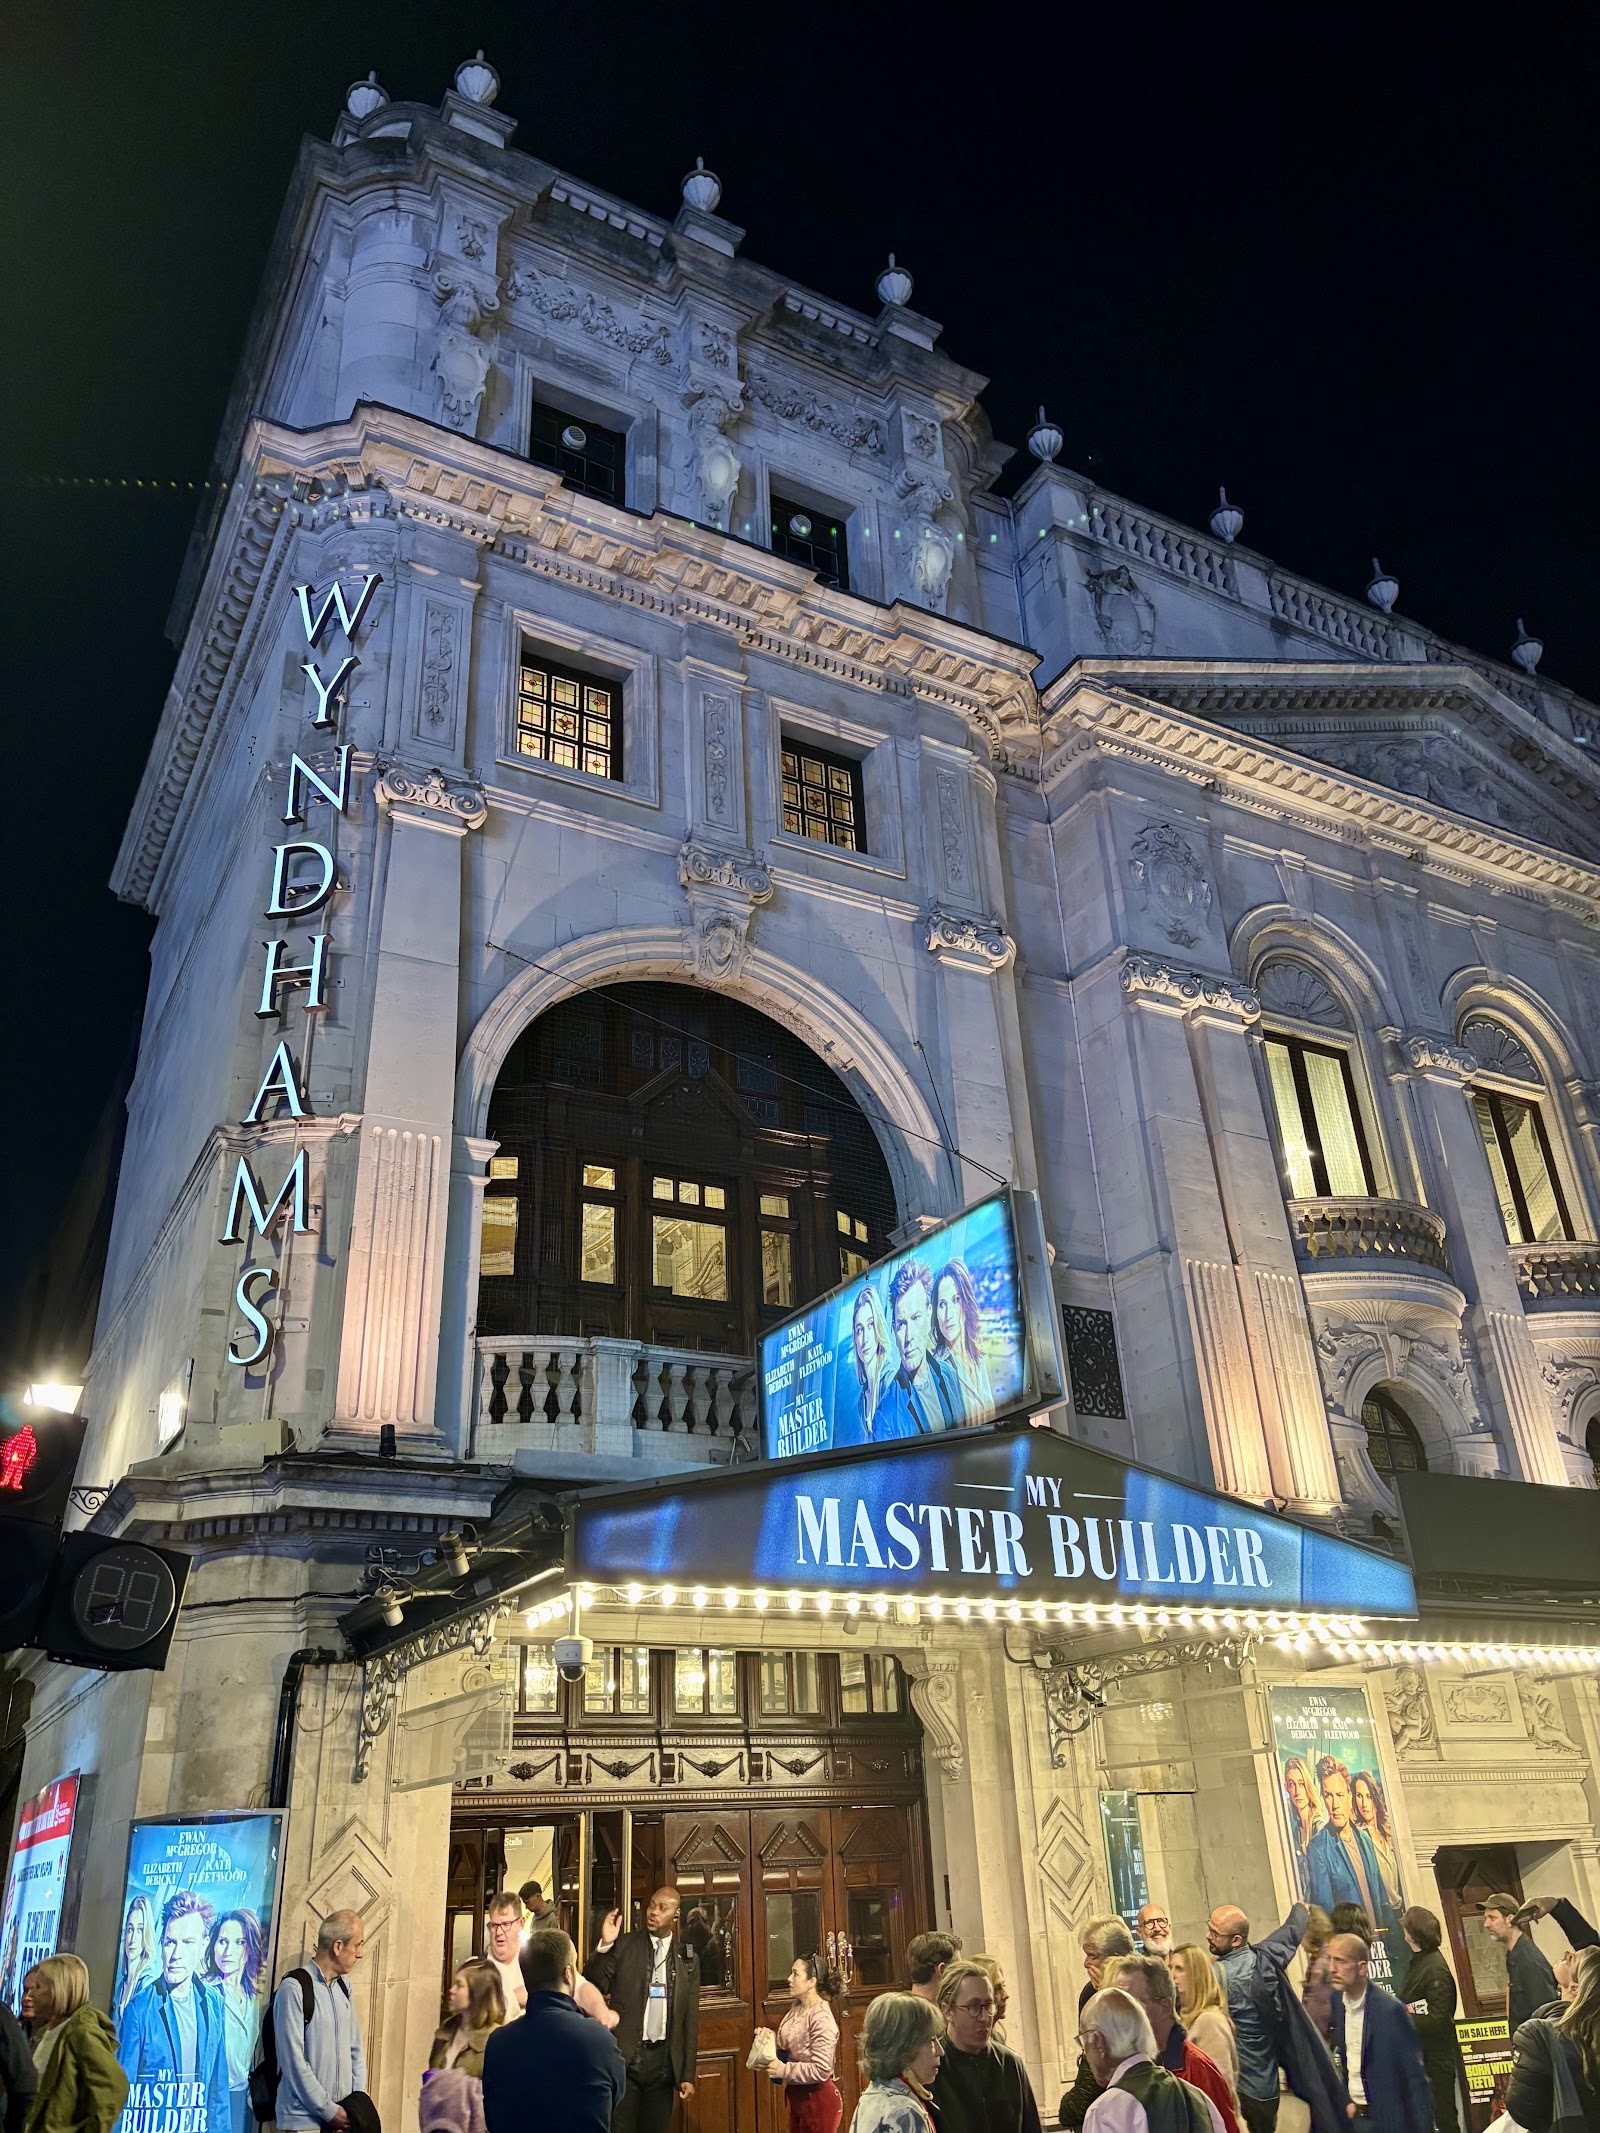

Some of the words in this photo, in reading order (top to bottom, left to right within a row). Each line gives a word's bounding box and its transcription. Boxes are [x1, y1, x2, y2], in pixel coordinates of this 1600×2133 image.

[220, 573, 384, 1366] WYNDHAMS
[788, 1321, 805, 1342] EWAN
[781, 1331, 813, 1359] McGREGOR
[808, 1343, 823, 1361] KATE
[765, 1359, 794, 1385] ELIZABETH
[800, 1350, 832, 1379] FLEETWOOD
[769, 1373, 791, 1395] DEBICKI
[796, 1392, 804, 1407] MY
[779, 1397, 824, 1438] MASTER
[778, 1419, 828, 1458] BUILDER
[1025, 1475, 1062, 1508] MY
[795, 1495, 1033, 1577] MASTER
[1047, 1514, 1273, 1588] BUILDER
[1309, 1696, 1327, 1706] EWAN
[1286, 1720, 1319, 1729] ELIZABETH
[1291, 1730, 1317, 1739] DEBICKI
[1324, 1731, 1359, 1739] FLEETWOOD
[179, 1831, 206, 1844] EWAN
[504, 1837, 523, 1846] Stalls
[166, 1843, 217, 1857] McGREGOR
[143, 1862, 182, 1874] ELIZABETH
[206, 1860, 231, 1871] KATE
[145, 1874, 176, 1886] DEBICKI
[188, 1871, 247, 1884] FLEETWOOD
[1459, 2029, 1470, 2039] ON
[1471, 2027, 1489, 2037] SALE
[1489, 2025, 1507, 2036] HERE
[157, 2069, 173, 2081] MY
[1465, 2063, 1491, 2077] BORN
[1490, 2061, 1514, 2075] WITH
[1467, 2075, 1495, 2089] TEETH
[127, 2082, 206, 2108] MASTER
[121, 2108, 208, 2133] BUILDER
